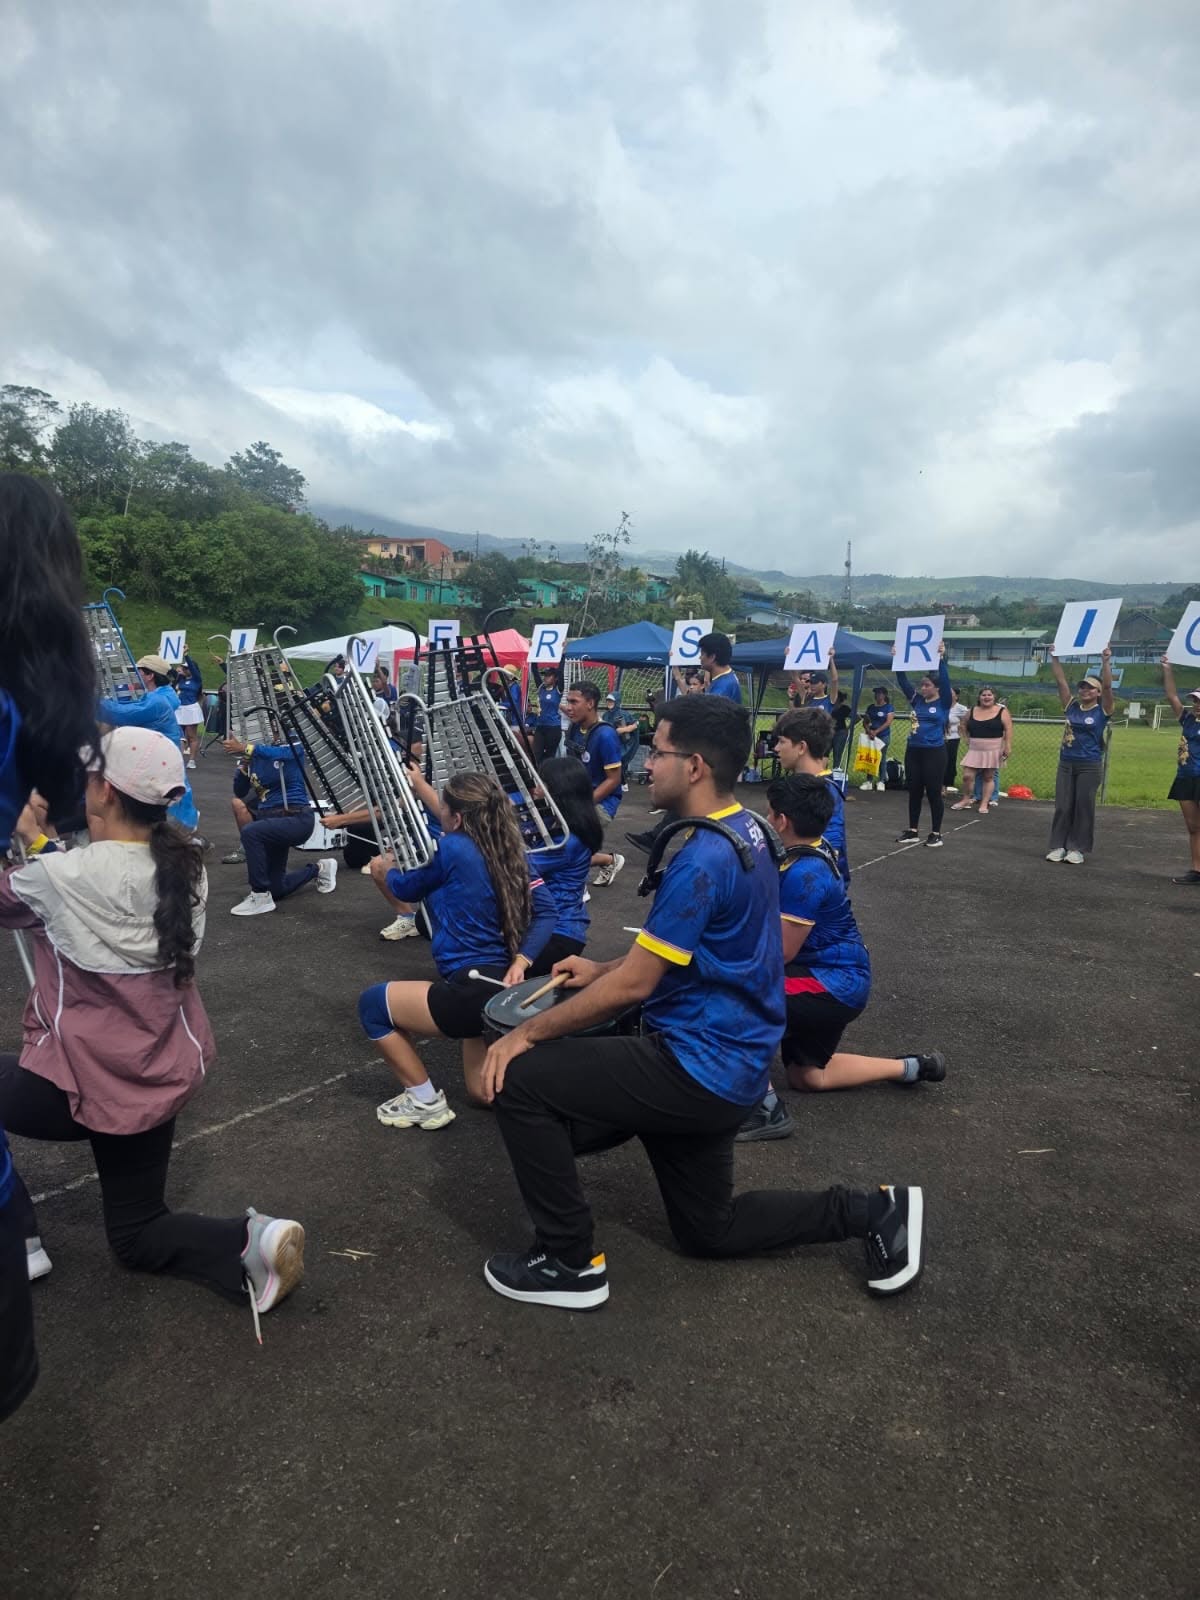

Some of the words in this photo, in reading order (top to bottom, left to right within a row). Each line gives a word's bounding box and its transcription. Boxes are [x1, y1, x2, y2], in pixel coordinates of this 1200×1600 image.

[536, 630, 560, 656] R
[679, 626, 702, 658] S
[1073, 609, 1097, 647] I
[163, 638, 181, 659] N
[355, 641, 374, 666] V
[795, 630, 822, 664] A
[904, 626, 934, 664] R
